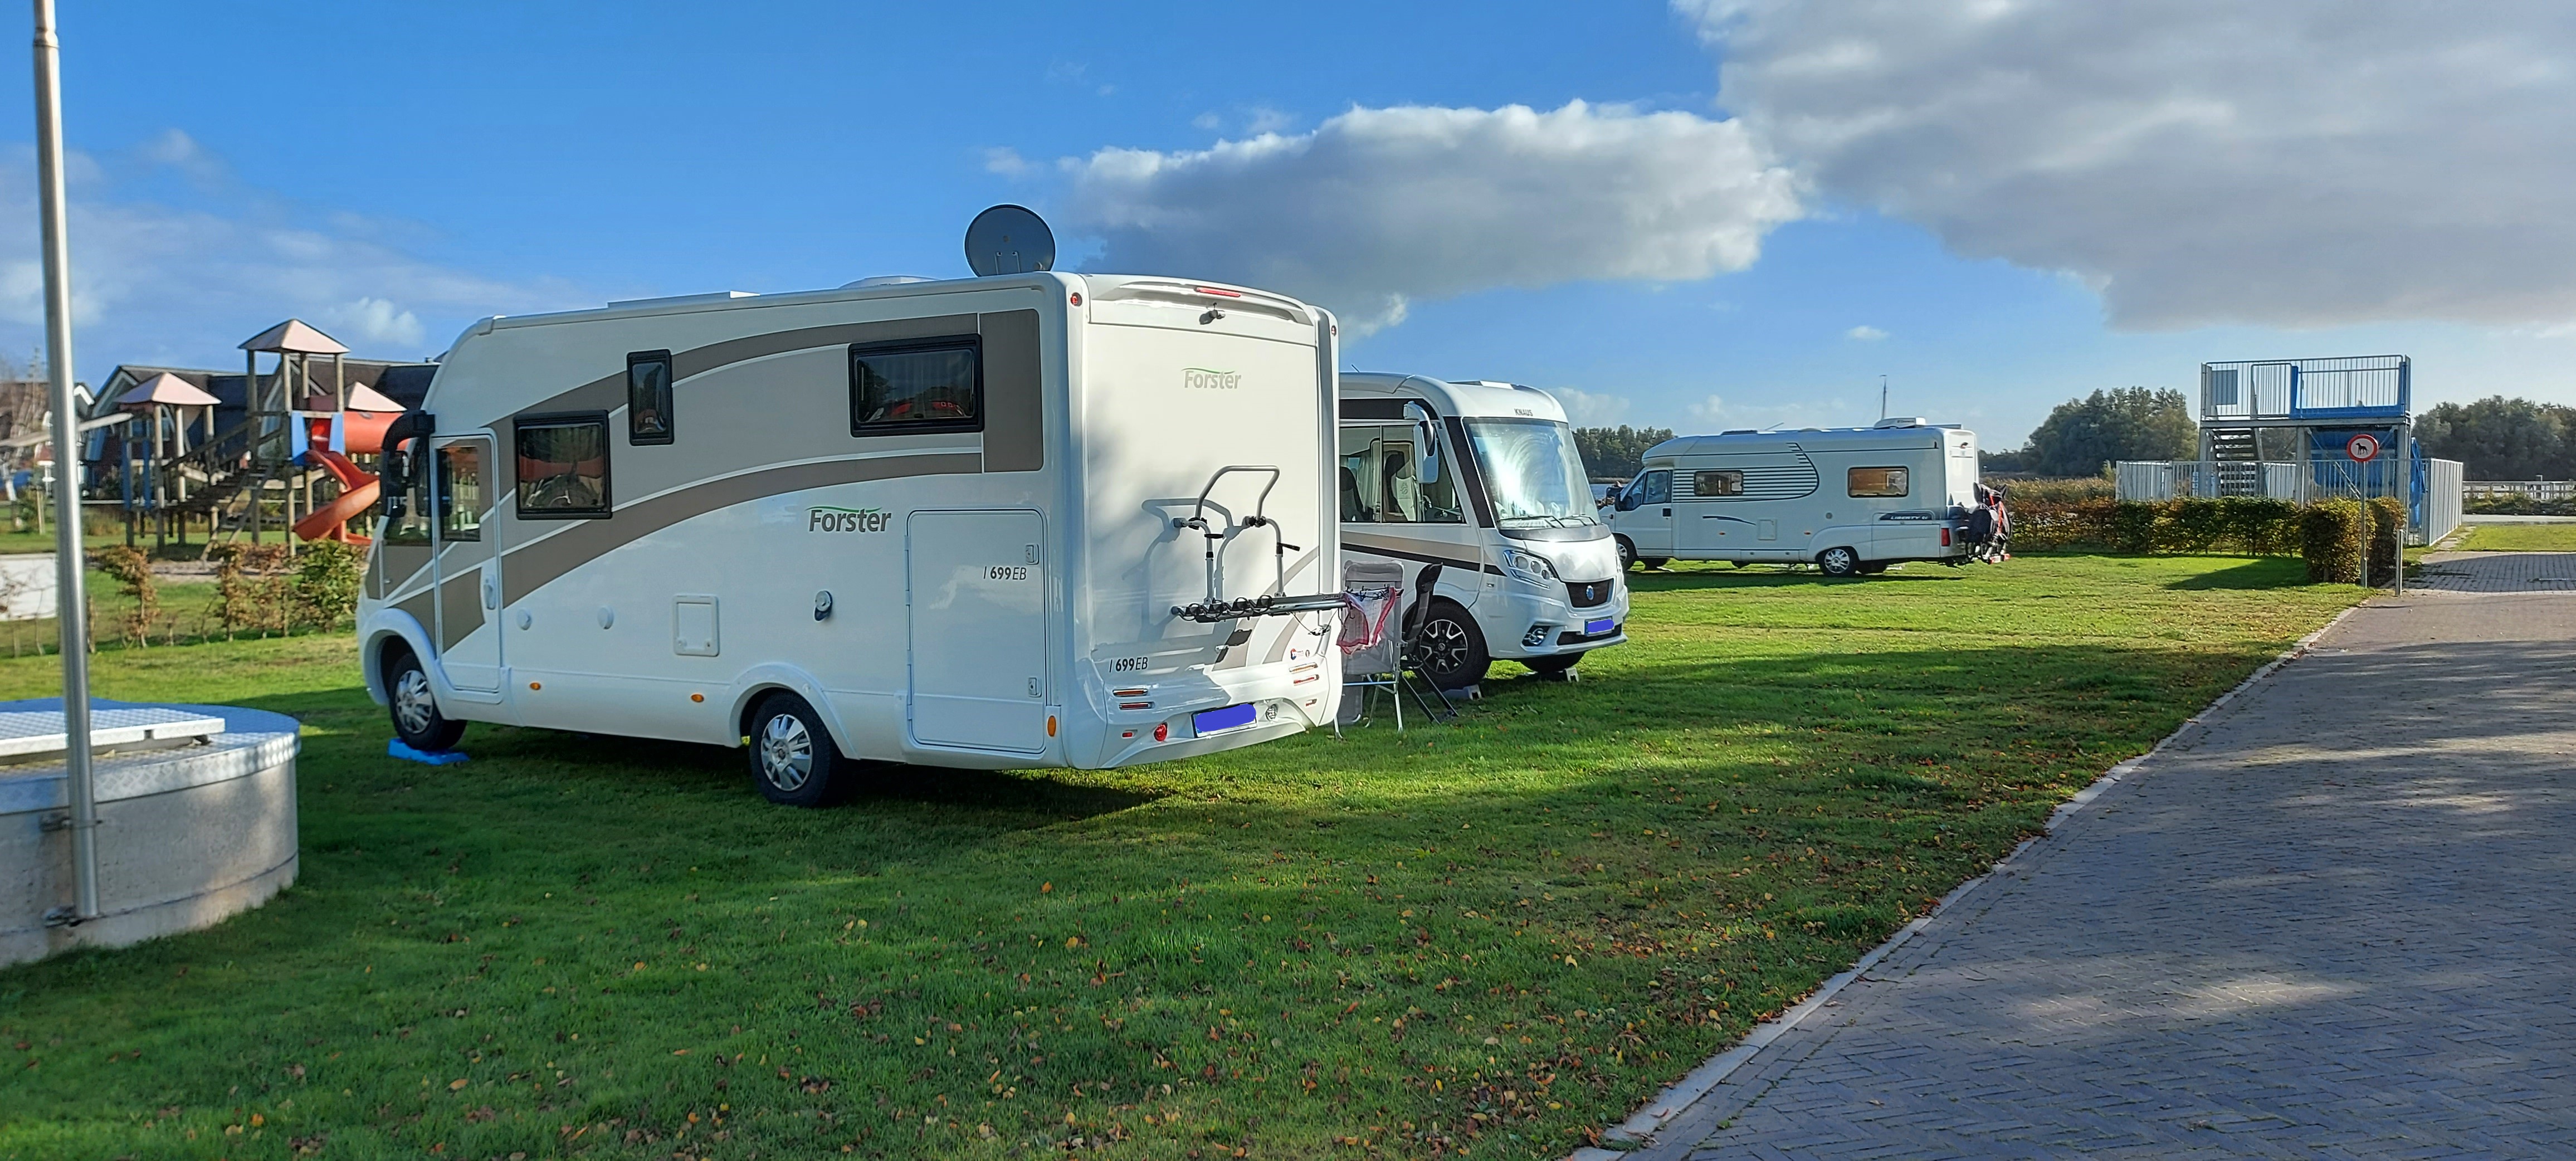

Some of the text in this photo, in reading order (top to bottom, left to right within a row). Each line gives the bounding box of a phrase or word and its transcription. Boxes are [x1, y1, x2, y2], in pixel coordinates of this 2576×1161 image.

[1184, 370, 1242, 389] Forster
[1514, 408, 1534, 417] KNAUS
[809, 509, 892, 533] Forster
